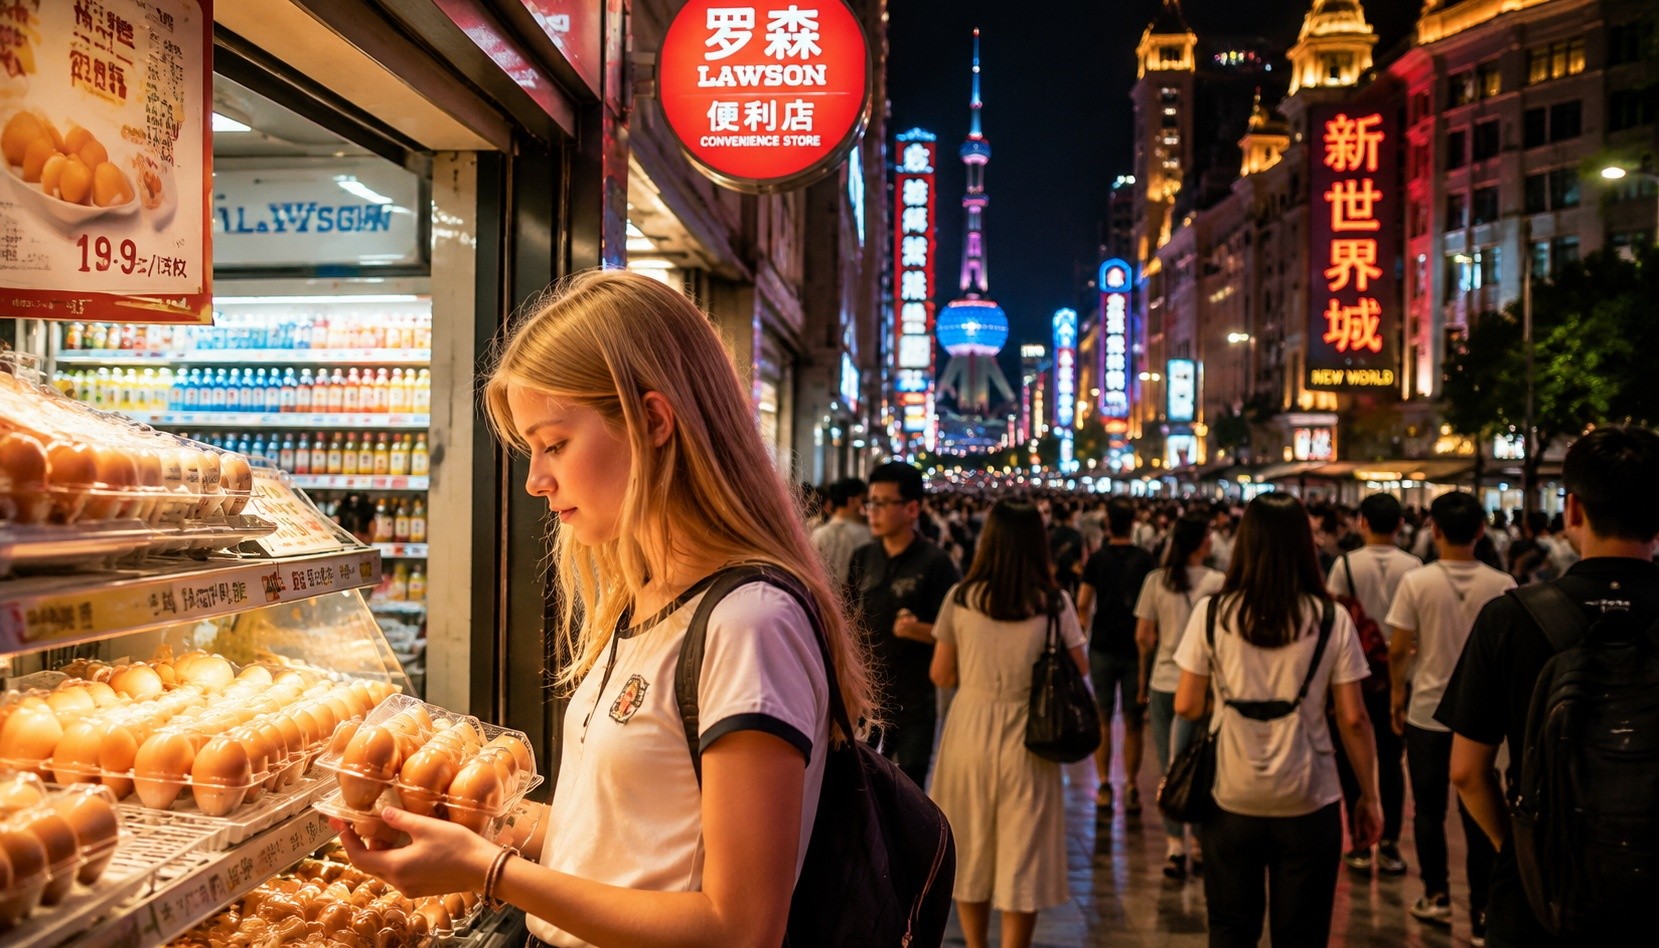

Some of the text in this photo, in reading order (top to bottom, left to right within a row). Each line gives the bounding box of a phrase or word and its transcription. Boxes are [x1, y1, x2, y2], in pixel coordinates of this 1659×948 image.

[704, 5, 822, 60] 罗森
[697, 64, 827, 87] LAWSON
[706, 99, 815, 132] 便利店
[700, 135, 821, 147] CONVENIENCE STORE
[1322, 113, 1384, 352] 新世界城
[1311, 369, 1394, 386] NEW WORLD
